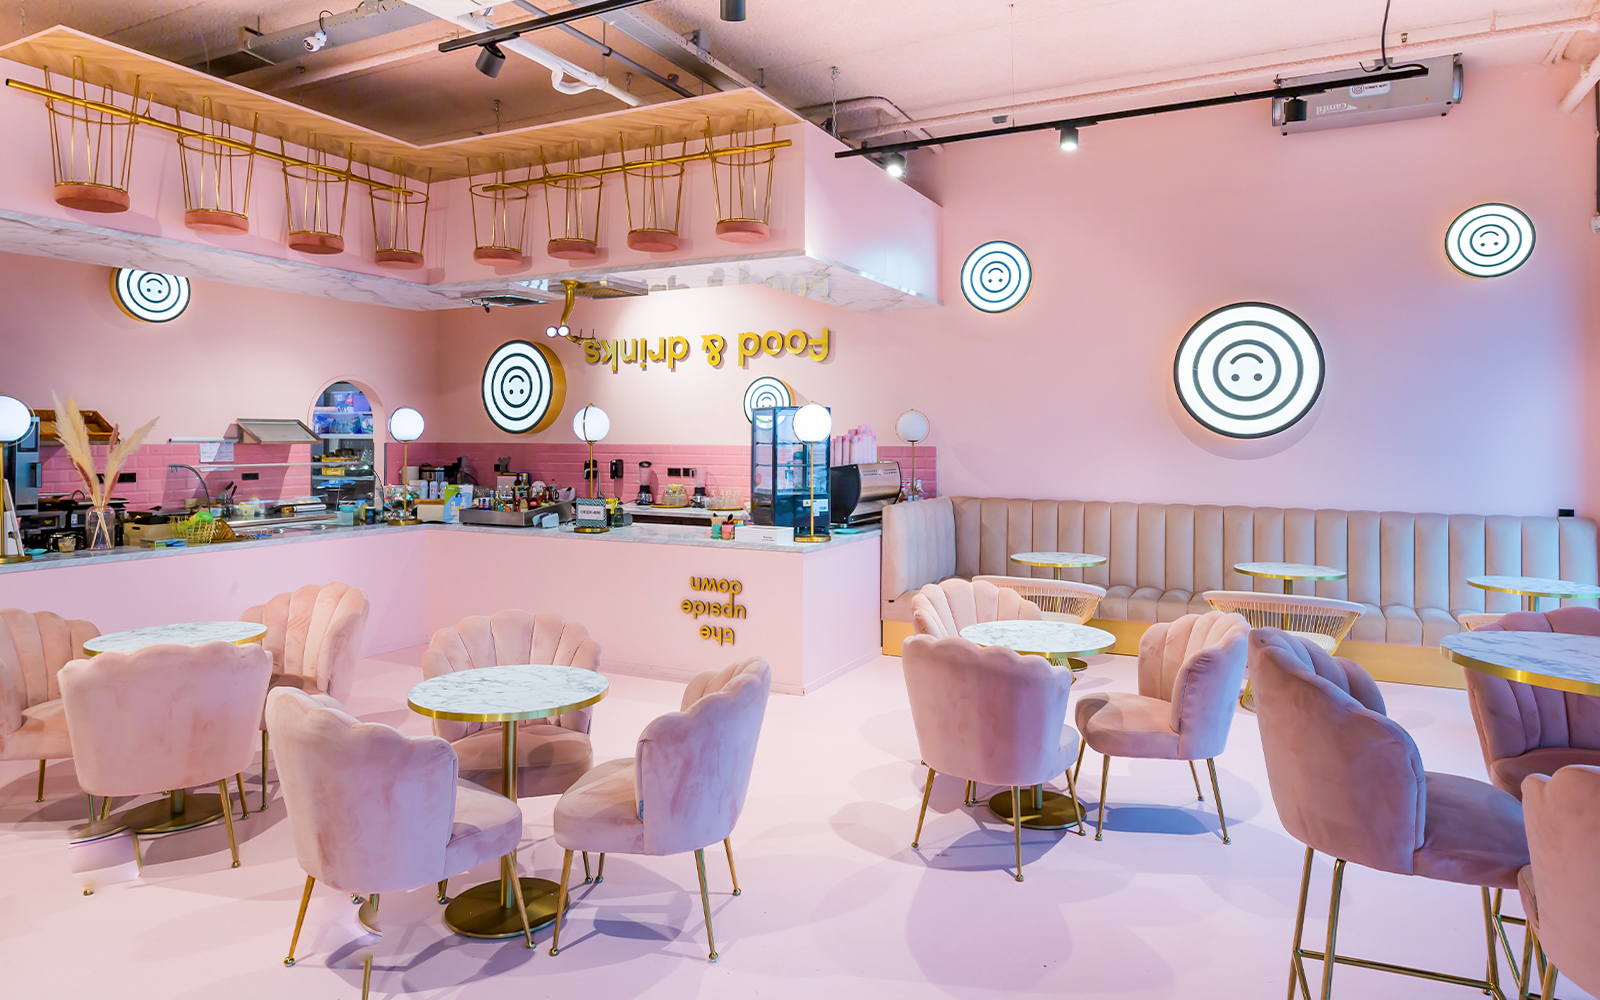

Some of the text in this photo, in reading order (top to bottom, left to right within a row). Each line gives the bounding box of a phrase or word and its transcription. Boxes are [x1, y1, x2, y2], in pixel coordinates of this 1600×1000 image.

[1316, 102, 1347, 115] camfil
[585, 328, 830, 371] Food & drinks
[690, 576, 742, 598] down
[681, 597, 746, 619] upside
[700, 625, 735, 646] the
